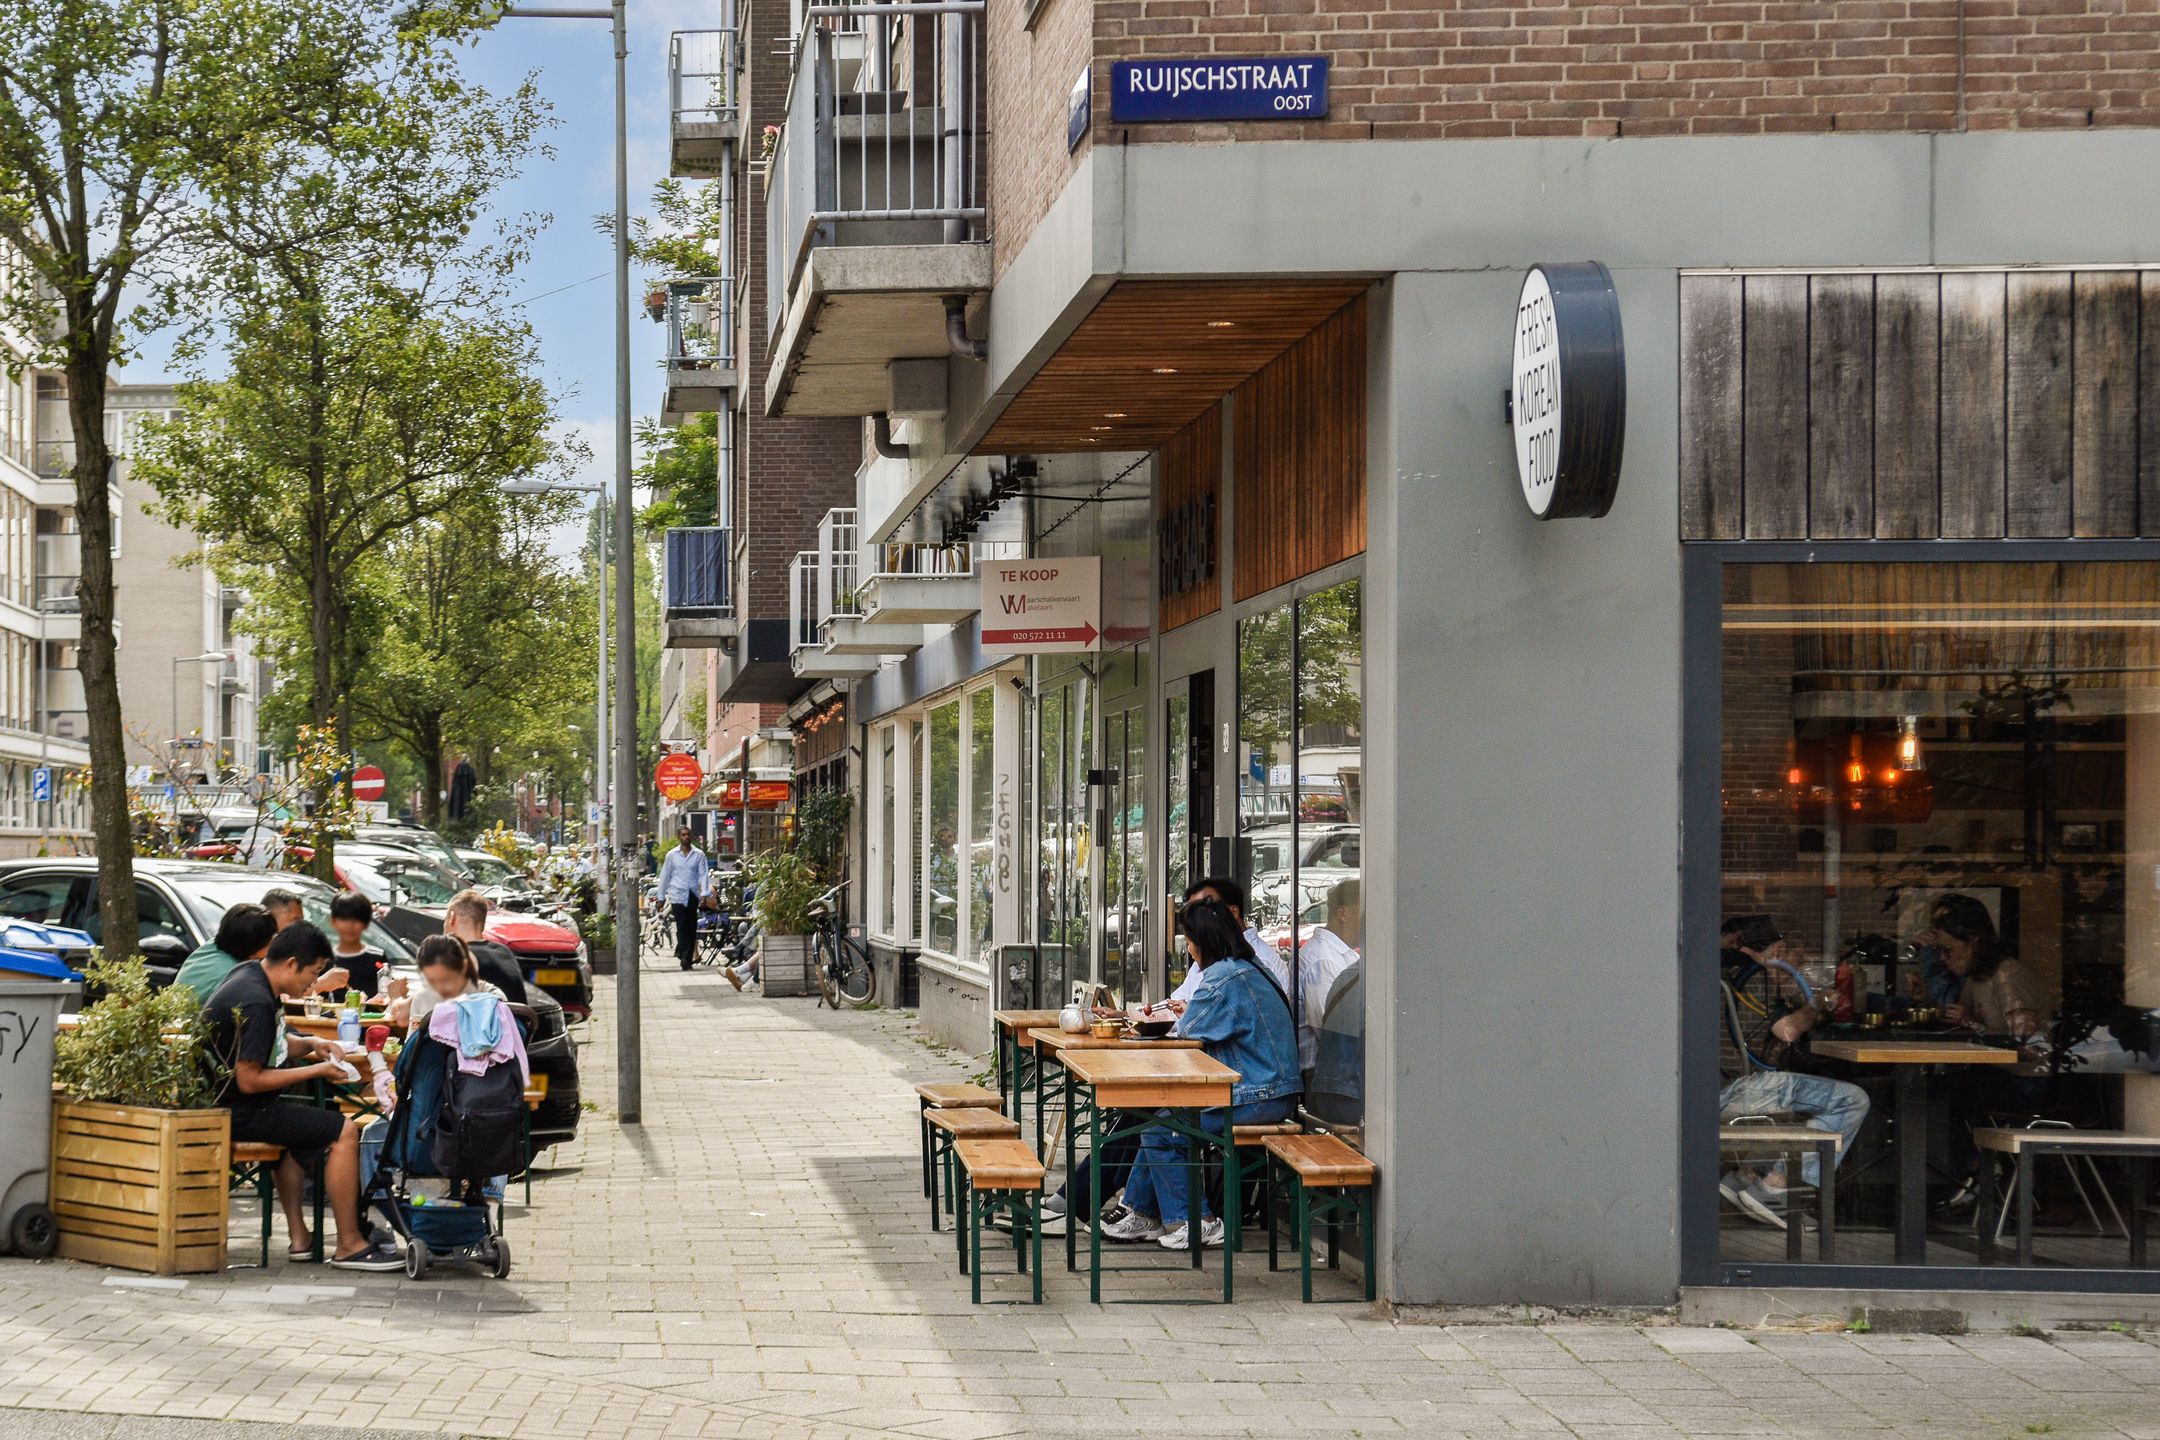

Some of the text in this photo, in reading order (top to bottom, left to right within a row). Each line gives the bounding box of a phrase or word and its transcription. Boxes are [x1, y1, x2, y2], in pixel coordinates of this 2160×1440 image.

[1130, 65, 1313, 98] RUIJSCHSTRAAT
[1273, 95, 1313, 110] OOST
[1520, 292, 1554, 359] FRESH
[1519, 356, 1559, 426] KOREAN
[1529, 427, 1555, 489] FOOD
[1000, 569, 1059, 582] TE KOOP
[1029, 632, 1045, 641] 572
[1057, 631, 1067, 639] 11
